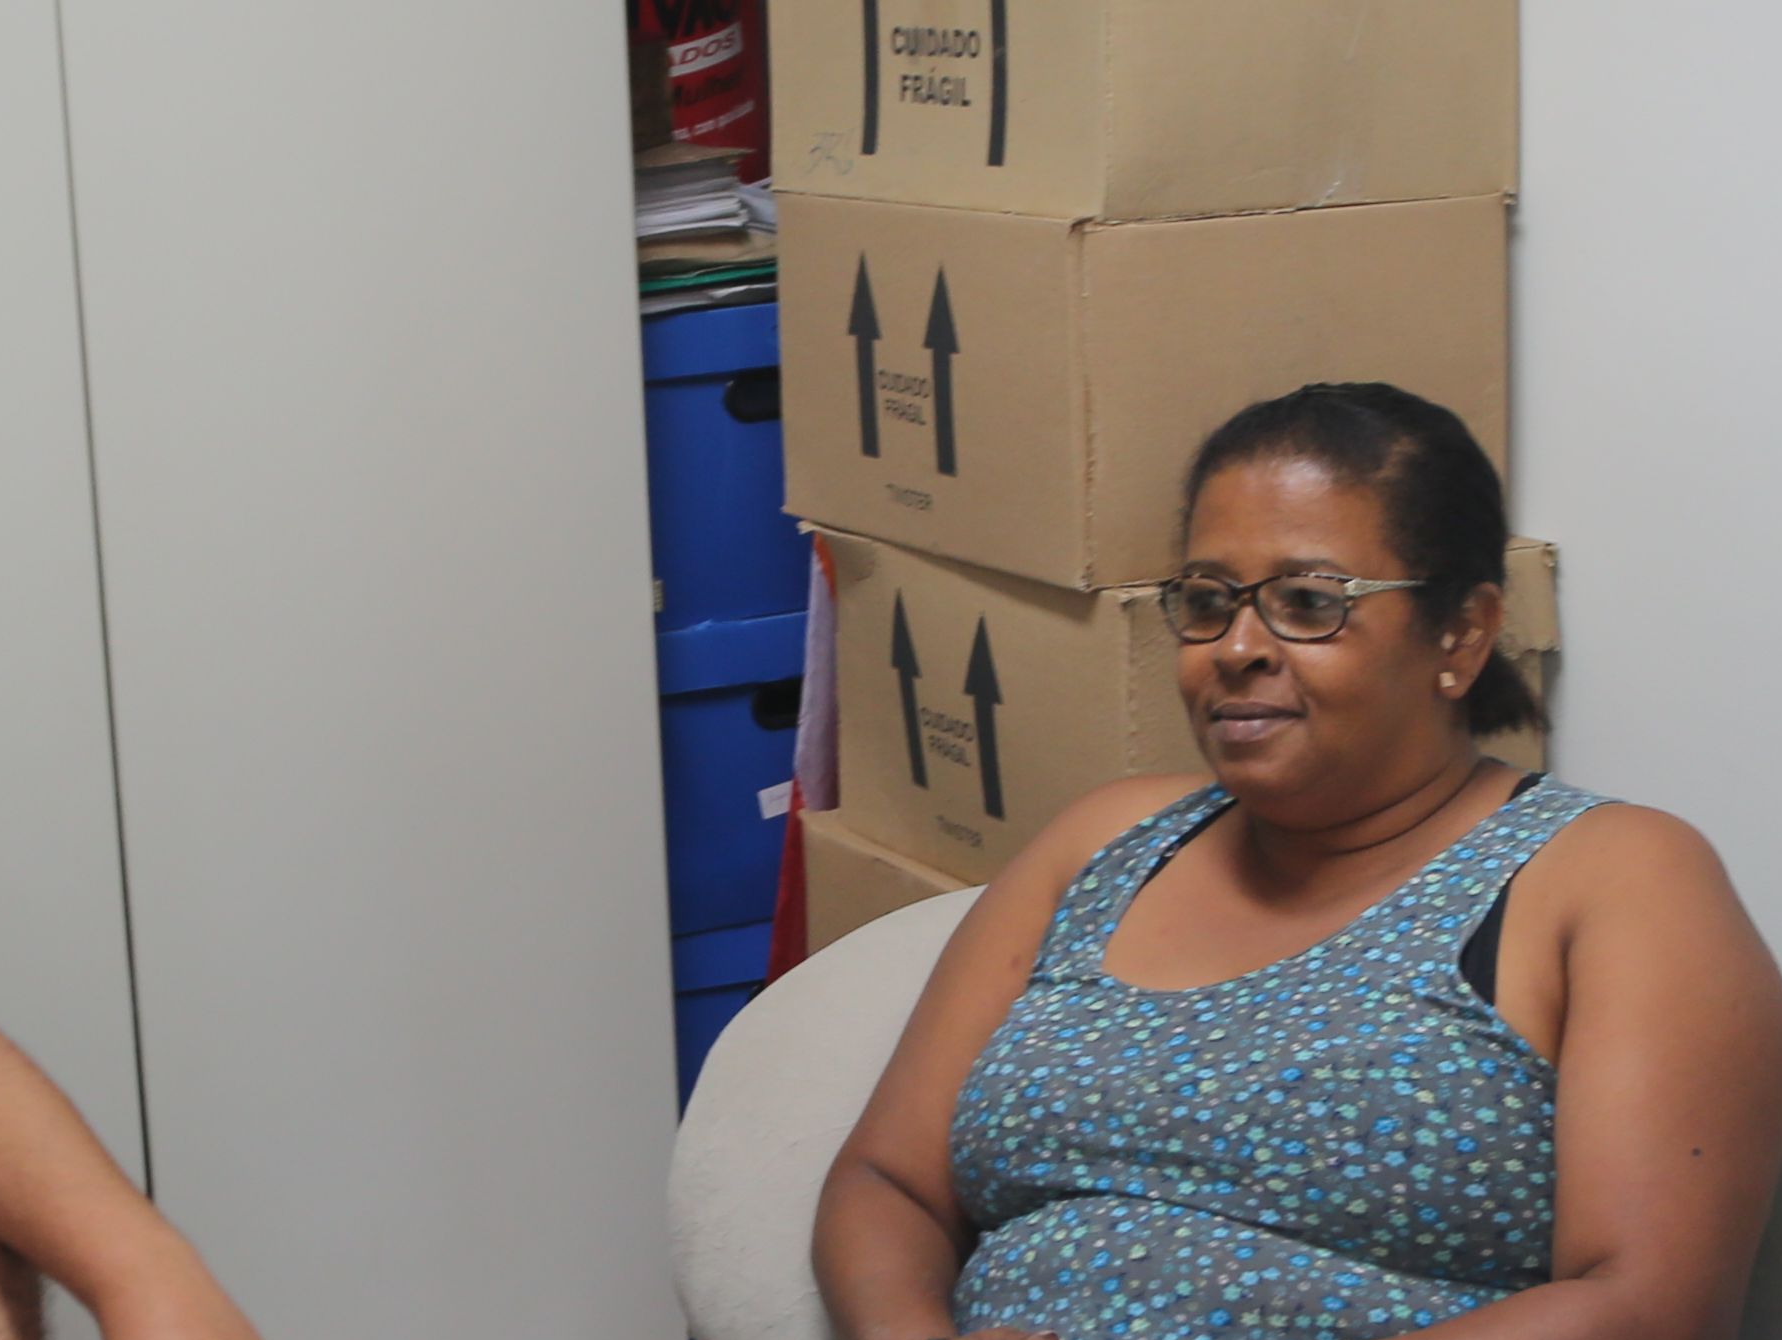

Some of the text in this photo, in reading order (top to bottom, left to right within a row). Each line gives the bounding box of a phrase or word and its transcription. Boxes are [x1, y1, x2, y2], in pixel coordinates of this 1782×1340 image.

[891, 26, 981, 59] CUIDADO
[899, 66, 971, 107] FRÁGIL
[878, 369, 930, 399] CUIDADO
[920, 706, 974, 743] CUIDADO
